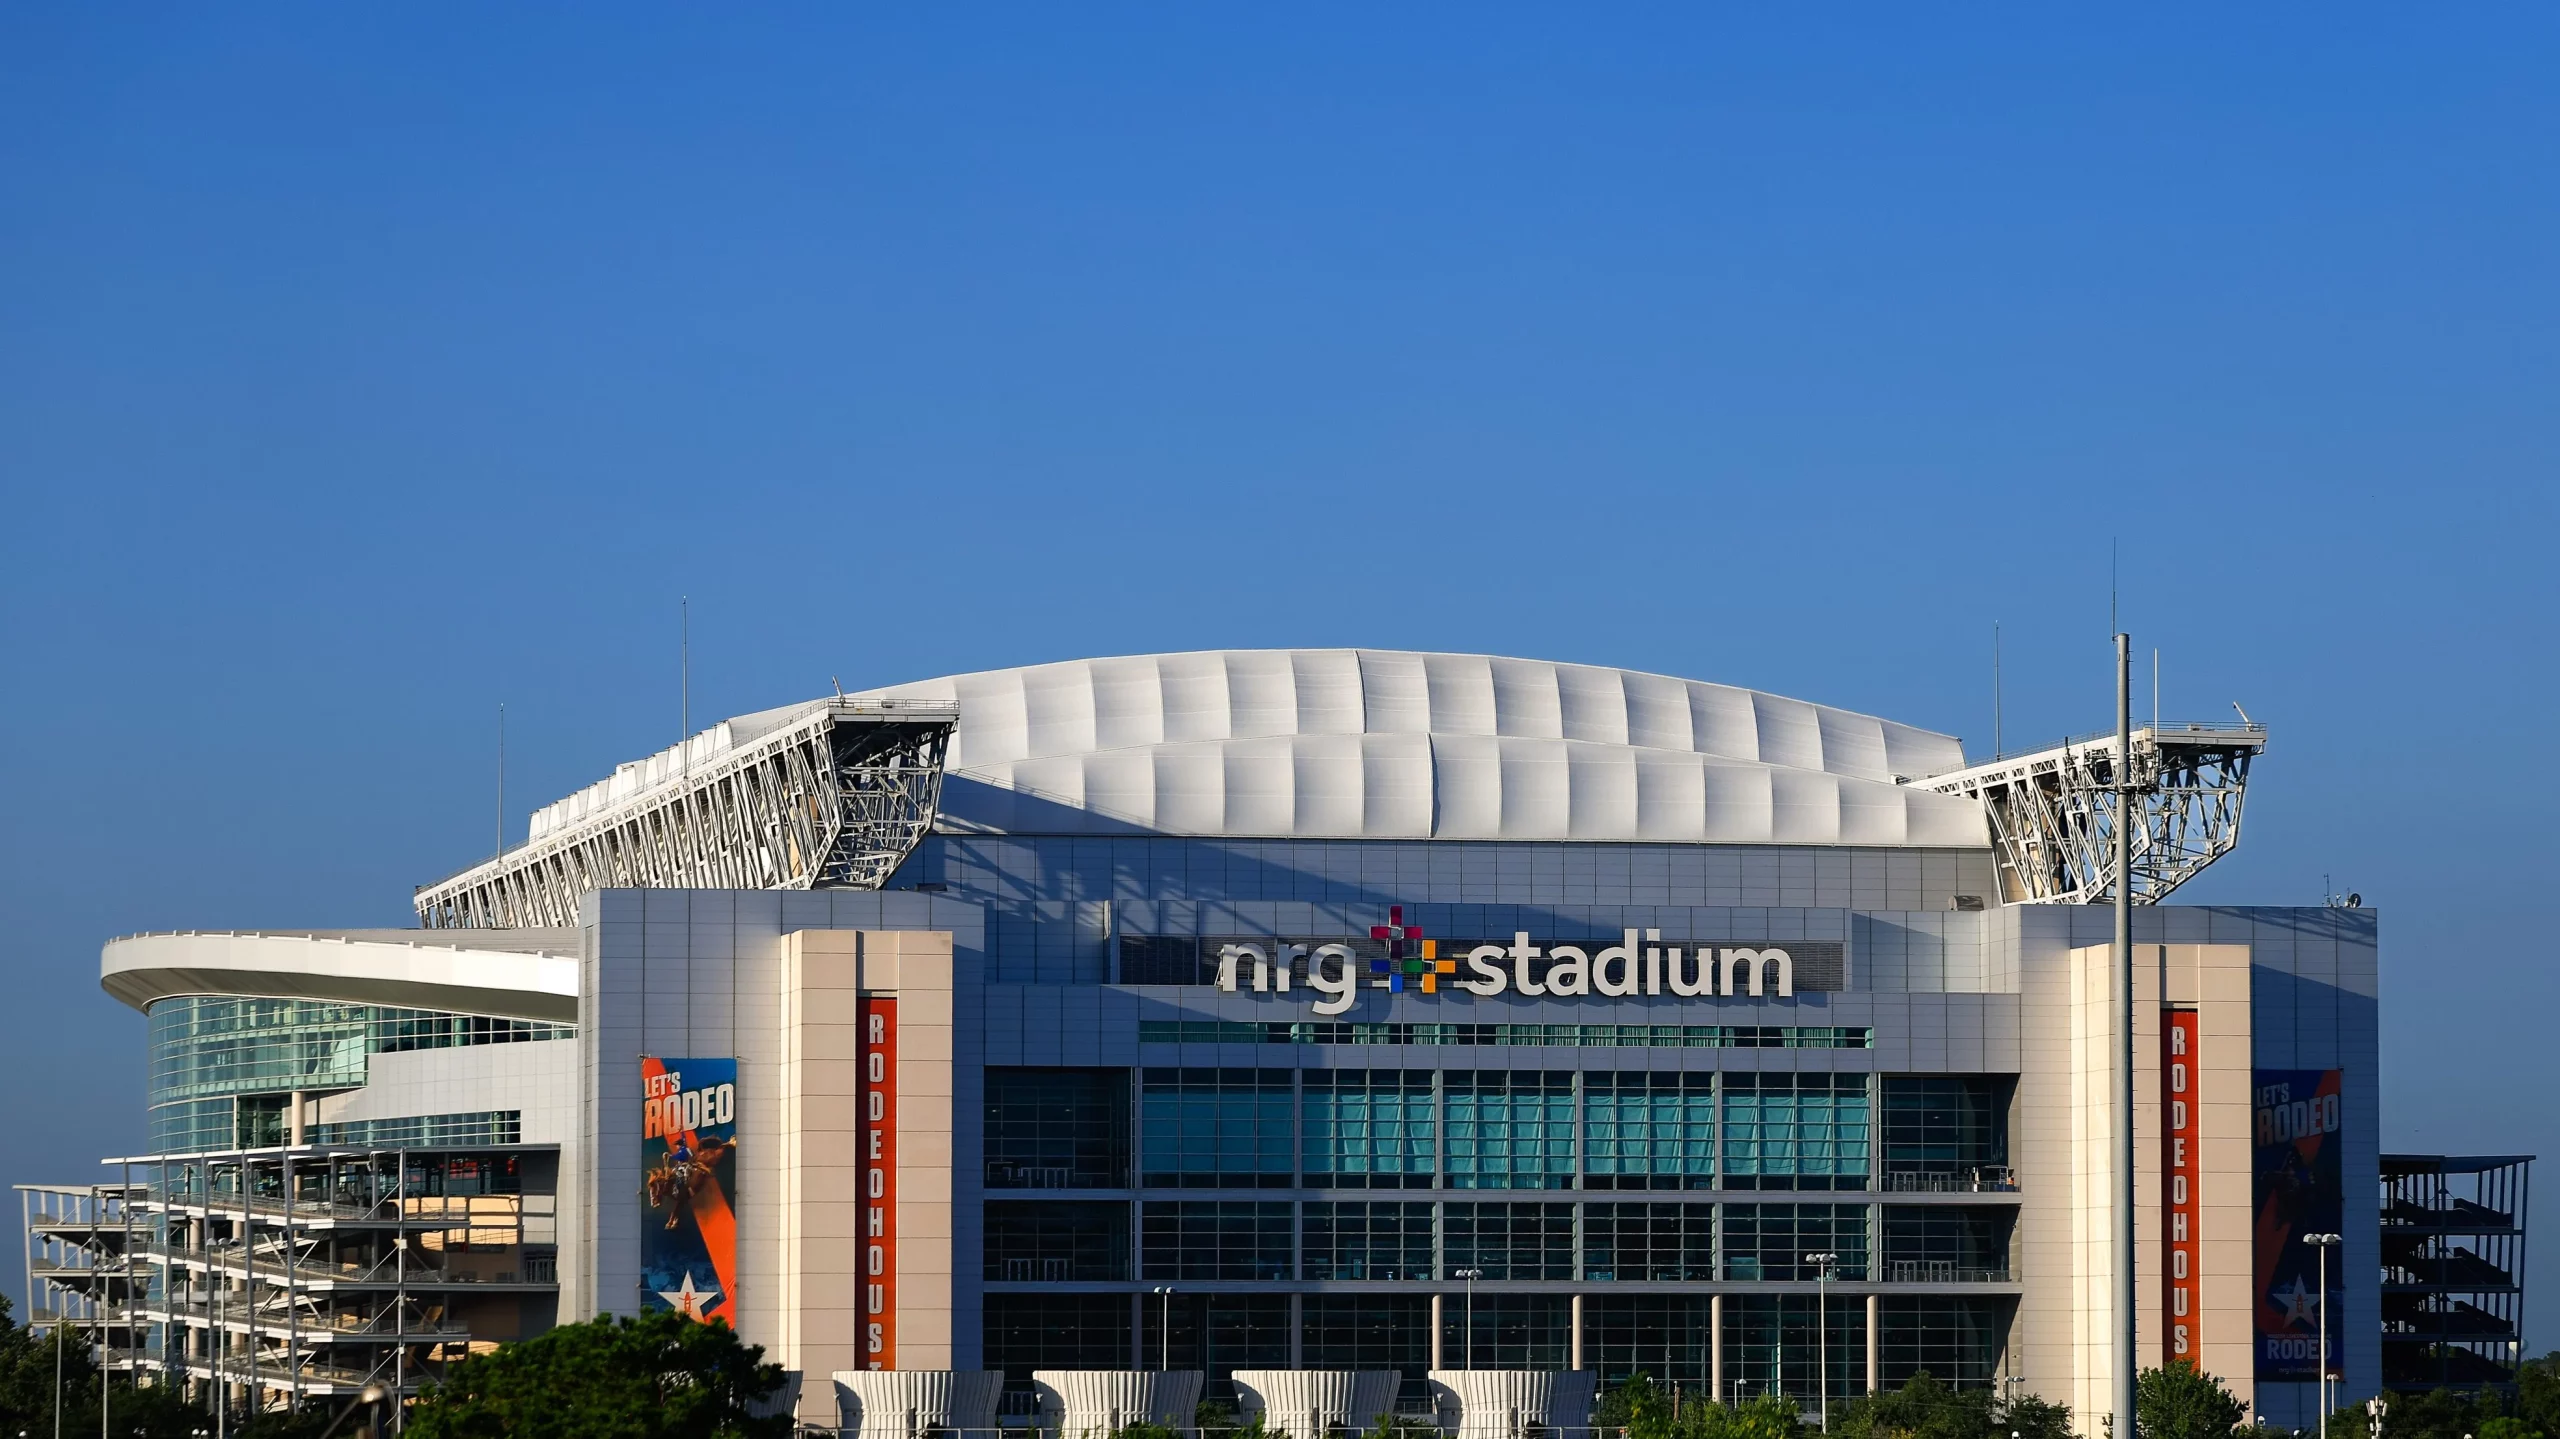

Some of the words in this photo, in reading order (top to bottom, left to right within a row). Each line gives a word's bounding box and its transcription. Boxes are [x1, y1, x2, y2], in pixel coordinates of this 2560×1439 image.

[1221, 942, 1357, 1015] nrg
[1466, 928, 1792, 997] stadium
[644, 1071, 681, 1098] LET'S
[2256, 1082, 2290, 1108] LET'S
[644, 1083, 734, 1139] RODEO
[2257, 1093, 2339, 1148] RODEO
[2267, 1339, 2332, 1360] RODEO
